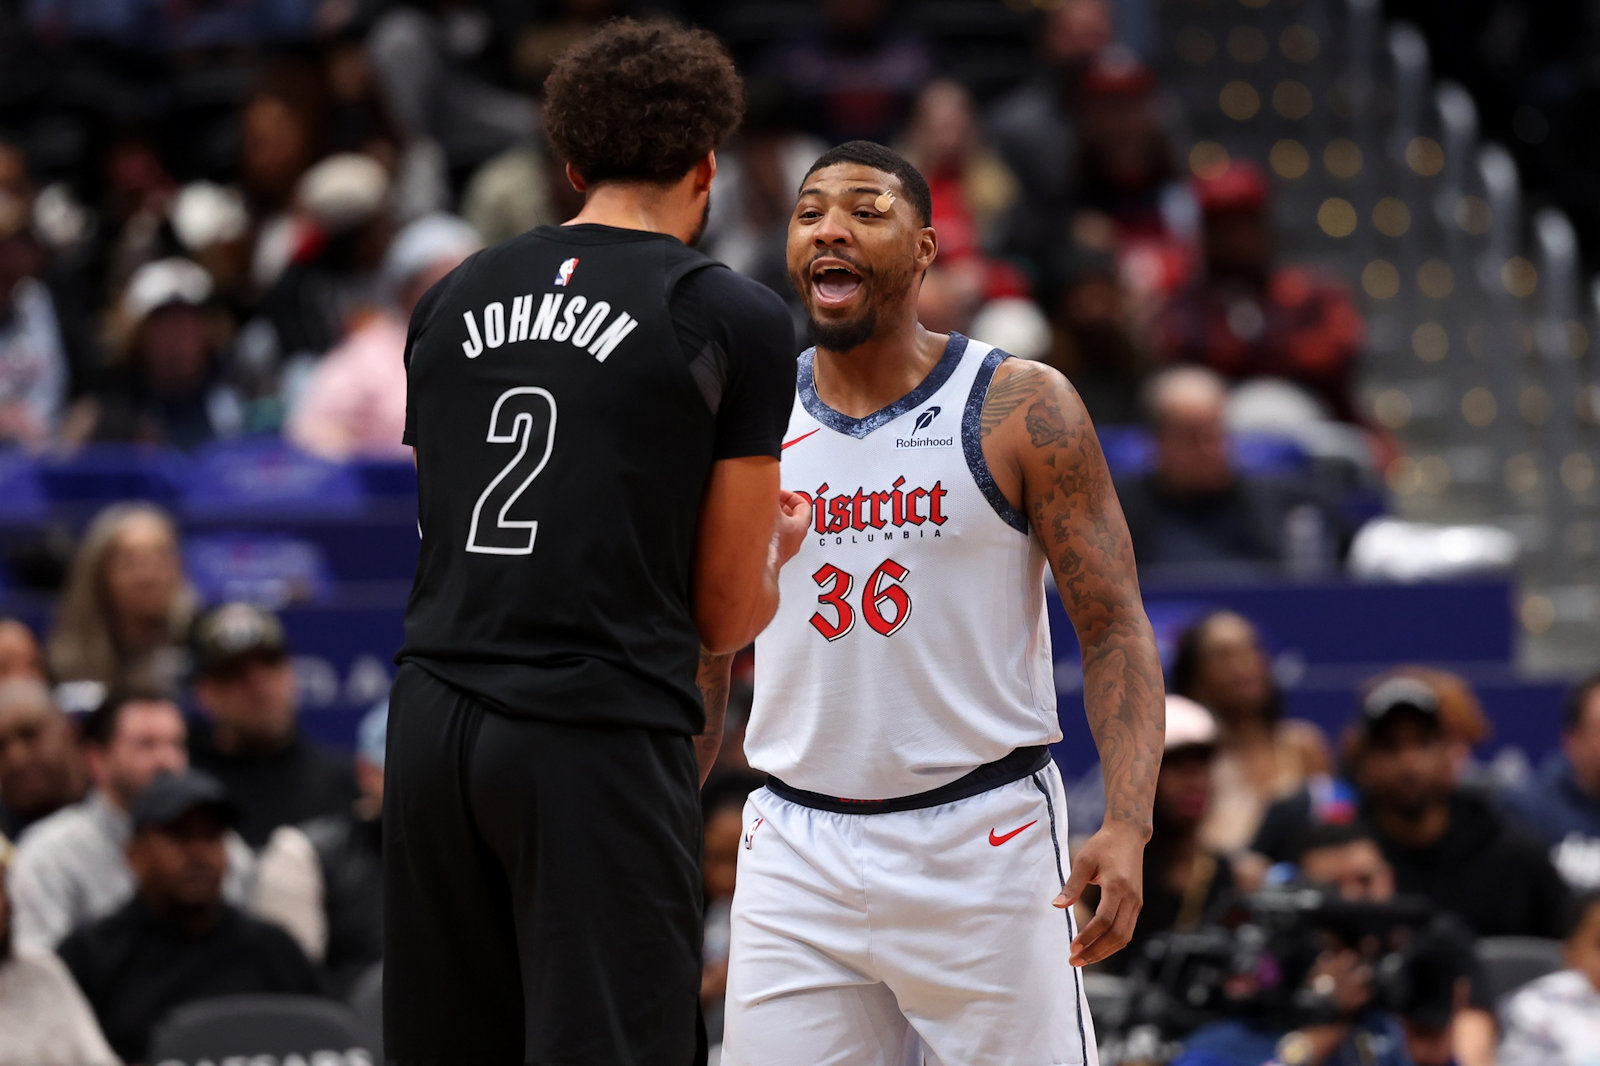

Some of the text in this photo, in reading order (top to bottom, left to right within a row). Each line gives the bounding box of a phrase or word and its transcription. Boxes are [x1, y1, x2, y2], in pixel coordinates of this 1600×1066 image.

[461, 293, 638, 363] JOHNSON
[465, 386, 557, 555] 2
[896, 437, 953, 448] Robinhood
[793, 475, 949, 535] istrict
[819, 529, 941, 547] COLUMBIA
[809, 558, 912, 642] 36
